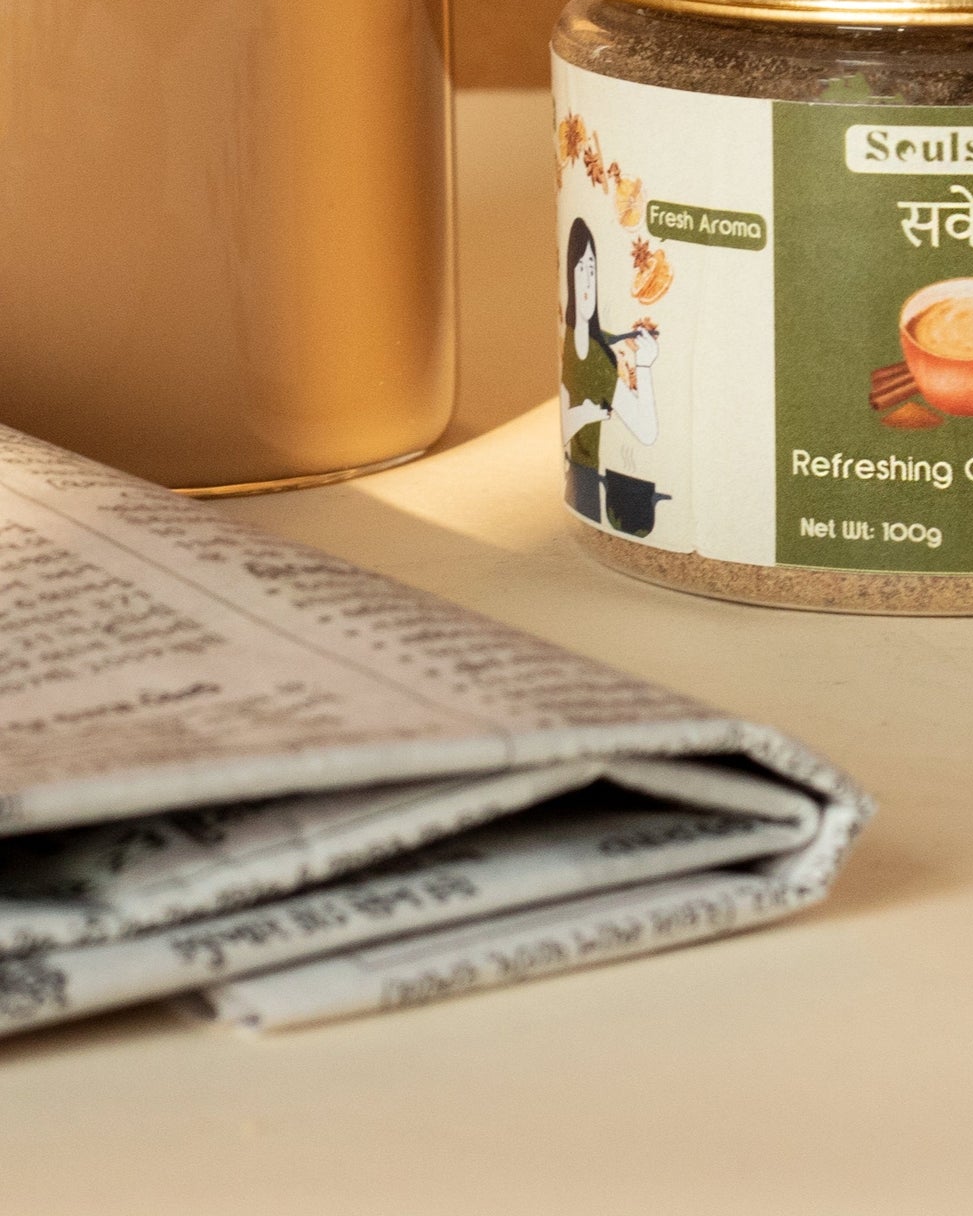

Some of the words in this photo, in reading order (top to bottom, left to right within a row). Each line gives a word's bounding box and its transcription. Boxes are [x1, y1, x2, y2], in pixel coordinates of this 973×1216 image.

[649, 205, 694, 230] Fresh
[699, 213, 762, 239] Aroma
[792, 448, 953, 490] Refreshing
[800, 517, 837, 540] Net
[841, 520, 876, 542] Wt:
[881, 522, 943, 549] 100g
